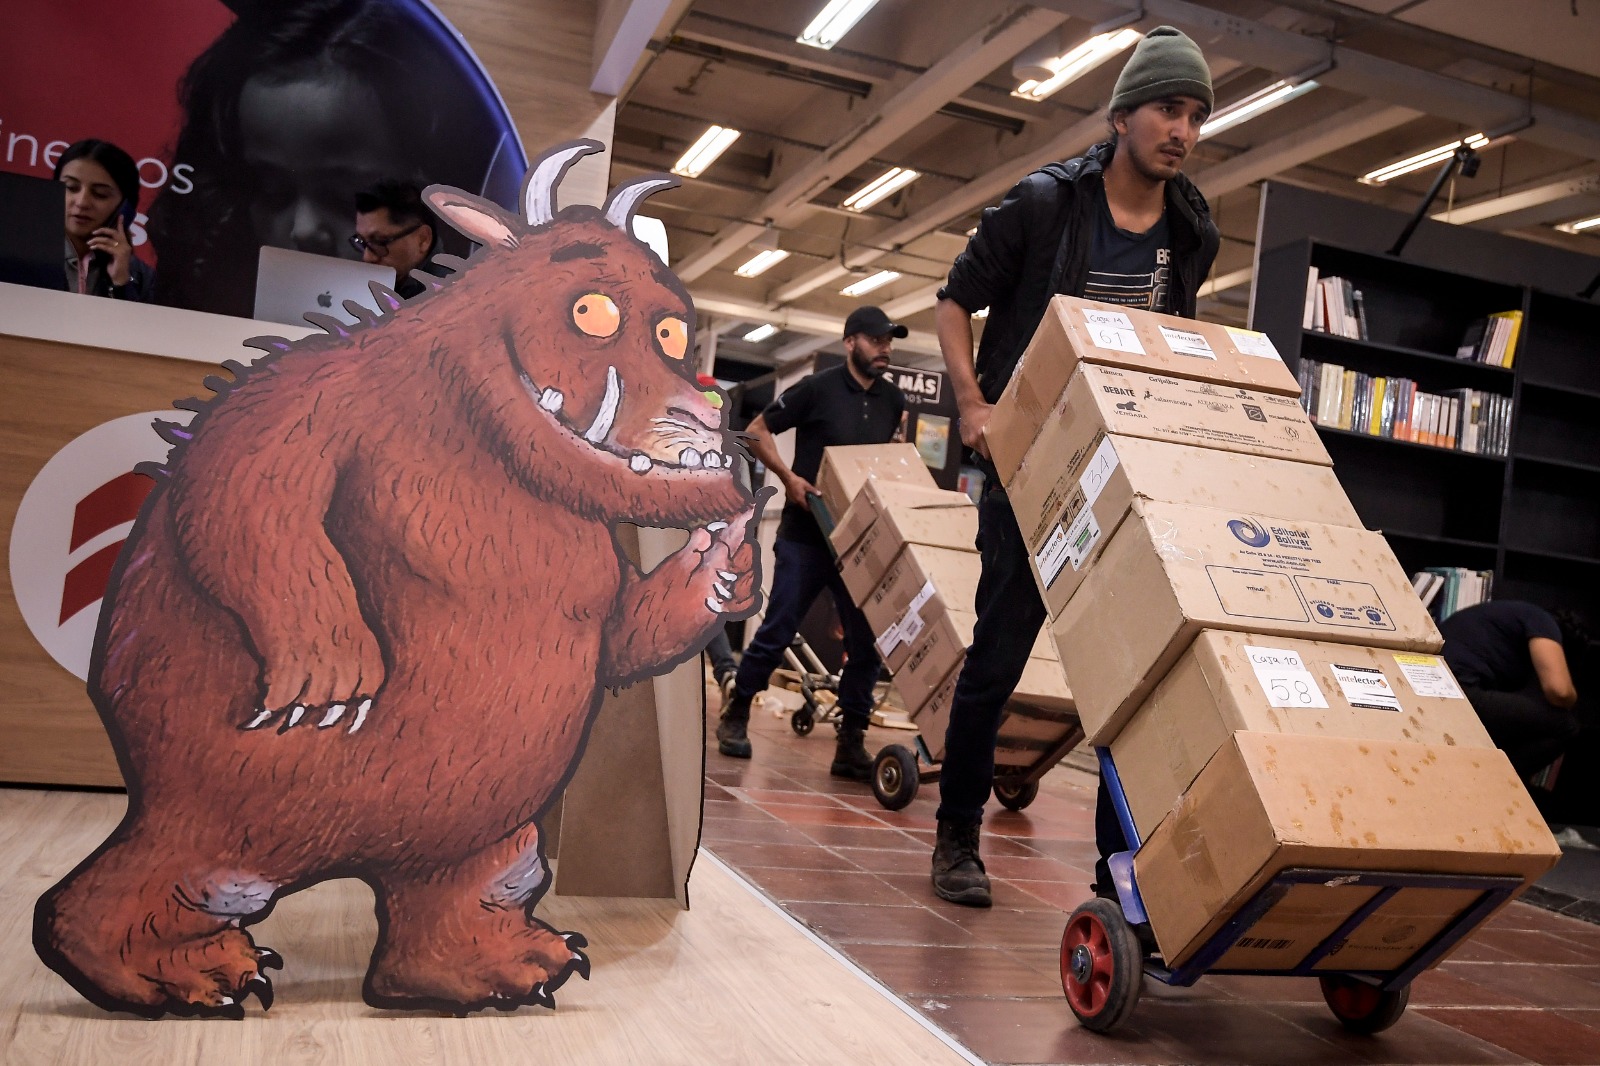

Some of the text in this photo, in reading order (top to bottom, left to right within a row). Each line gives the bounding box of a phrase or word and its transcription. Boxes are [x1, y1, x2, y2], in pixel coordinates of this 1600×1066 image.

[898, 372, 937, 395] MÁS
[1103, 385, 1136, 397] DEBATE
[1086, 454, 1110, 493] 34
[1270, 526, 1310, 539] Editorial
[1284, 656, 1298, 666] 10
[1338, 674, 1376, 685] intelecto
[1270, 678, 1312, 704] 58
